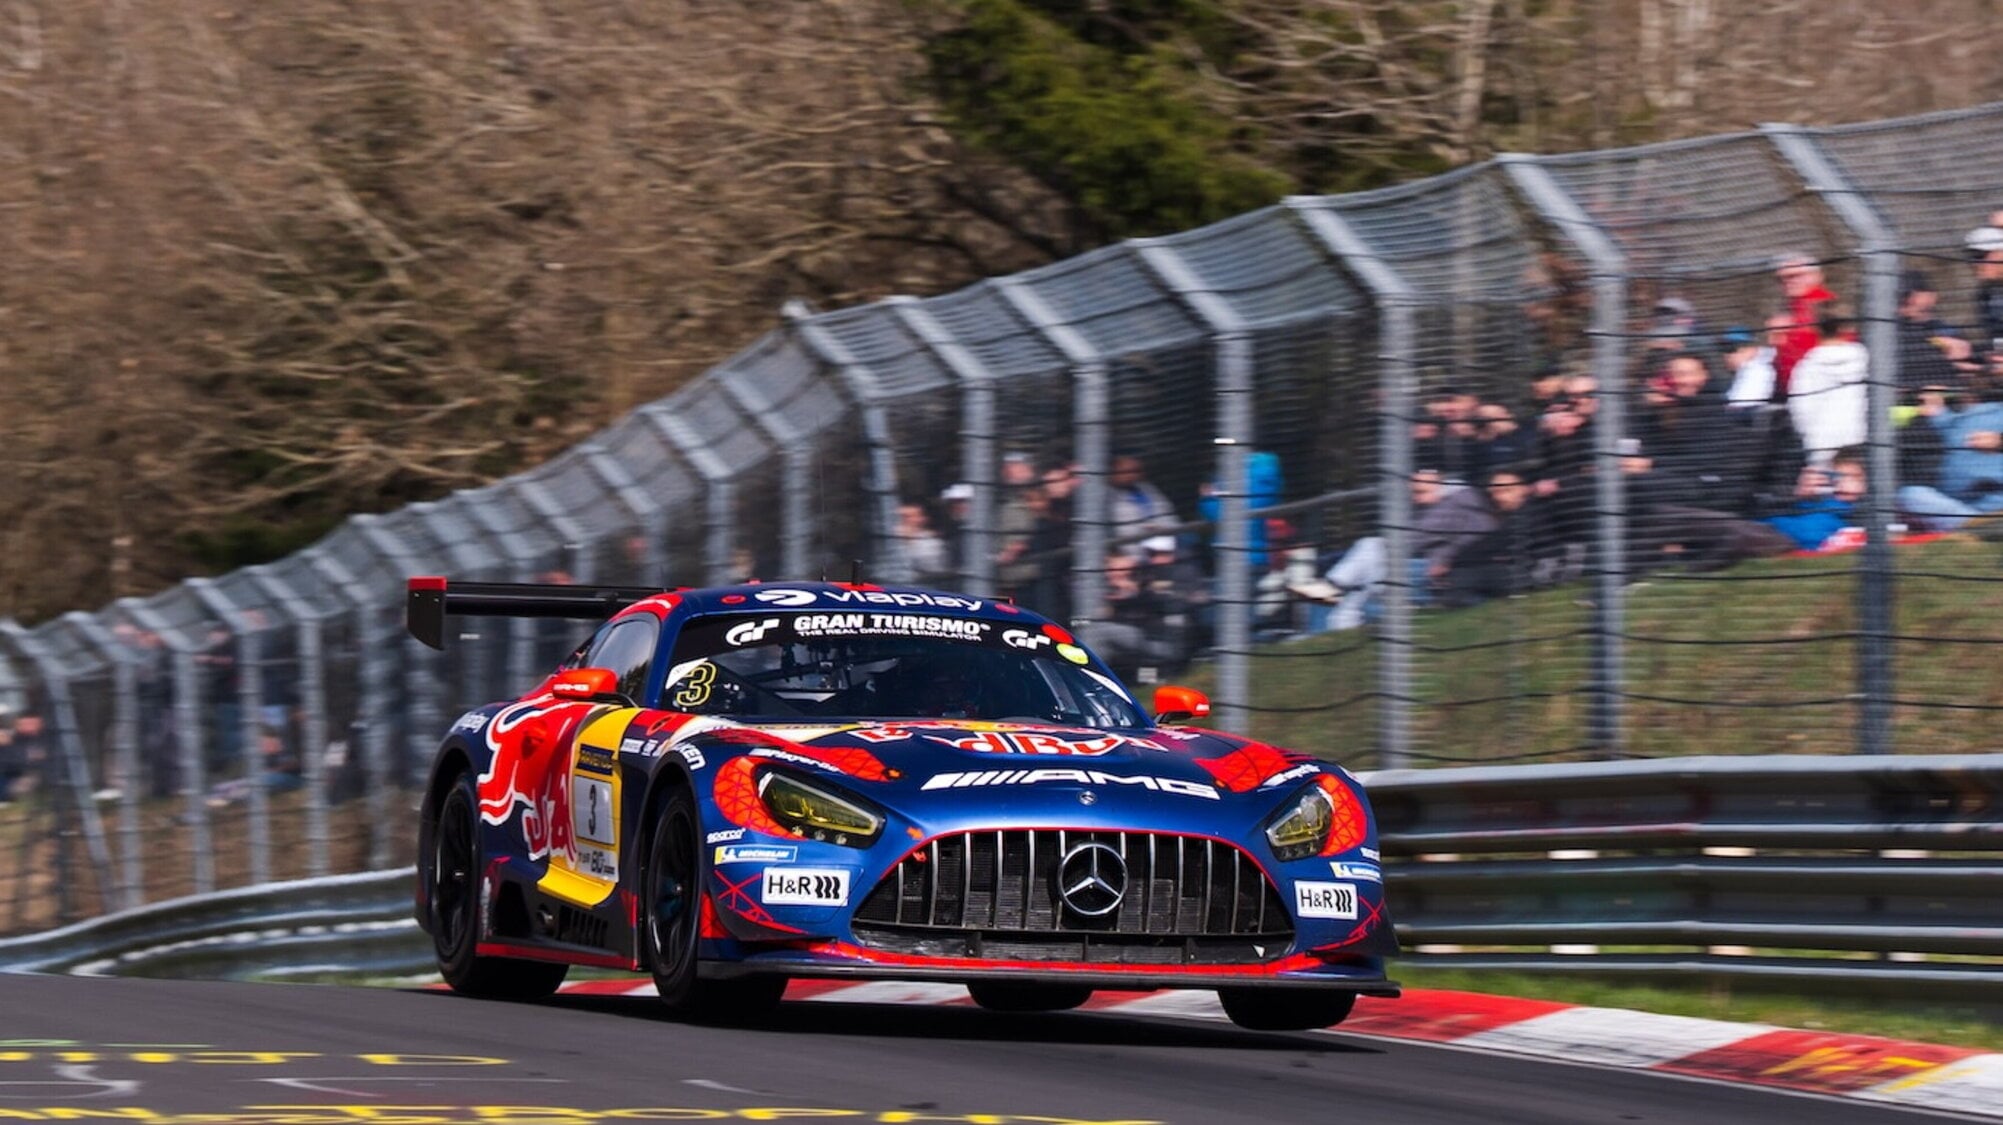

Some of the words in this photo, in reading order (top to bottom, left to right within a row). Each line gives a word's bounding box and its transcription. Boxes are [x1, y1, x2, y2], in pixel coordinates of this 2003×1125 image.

[823, 589, 983, 612] viaplay
[794, 613, 865, 632] GRAN
[871, 614, 981, 635] TURISMO
[797, 629, 823, 637] THE
[860, 627, 911, 636] DRIVING
[913, 629, 982, 642] SIMULATOR
[676, 662, 716, 706] 3
[1019, 768, 1221, 800] AMG
[587, 784, 598, 836] 3
[767, 875, 812, 896] H&R
[1300, 888, 1333, 908] H&R
